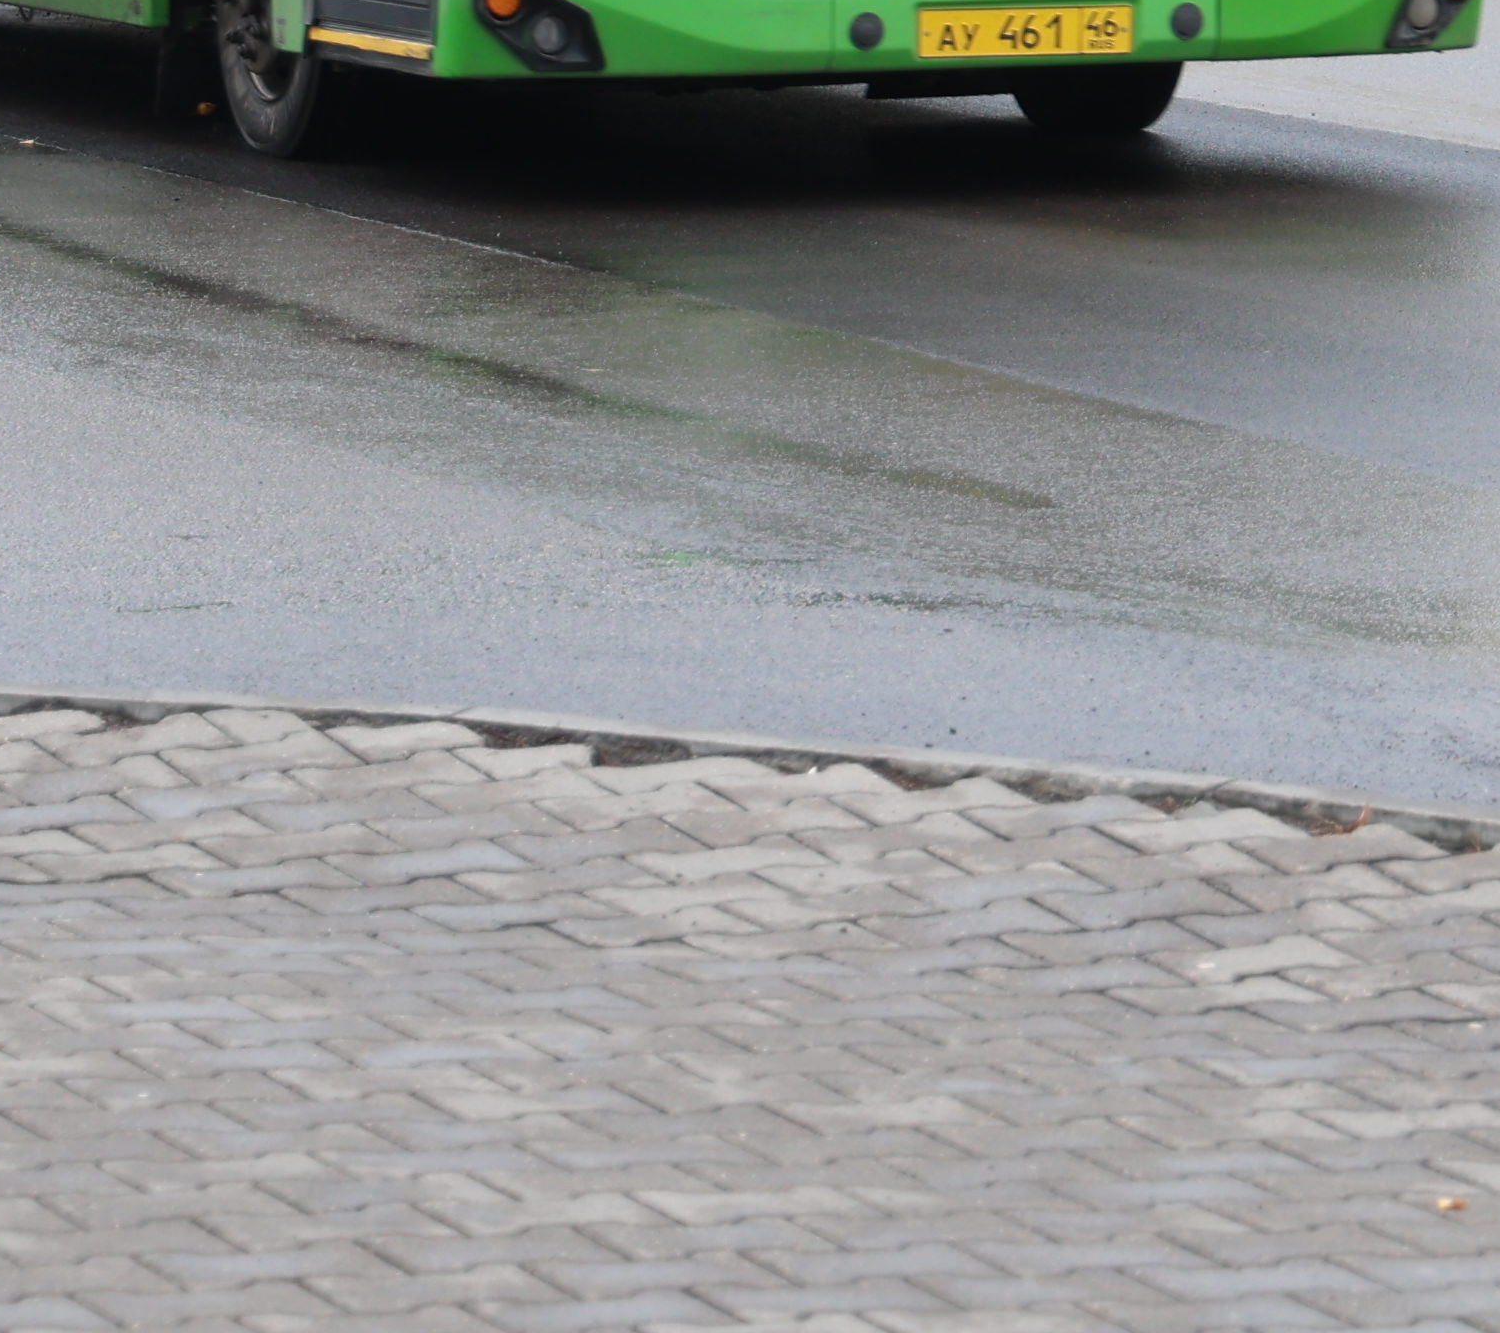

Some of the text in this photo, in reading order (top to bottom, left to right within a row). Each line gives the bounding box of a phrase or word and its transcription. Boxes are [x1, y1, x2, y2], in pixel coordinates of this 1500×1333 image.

[936, 10, 1120, 51] АУ 461 46
